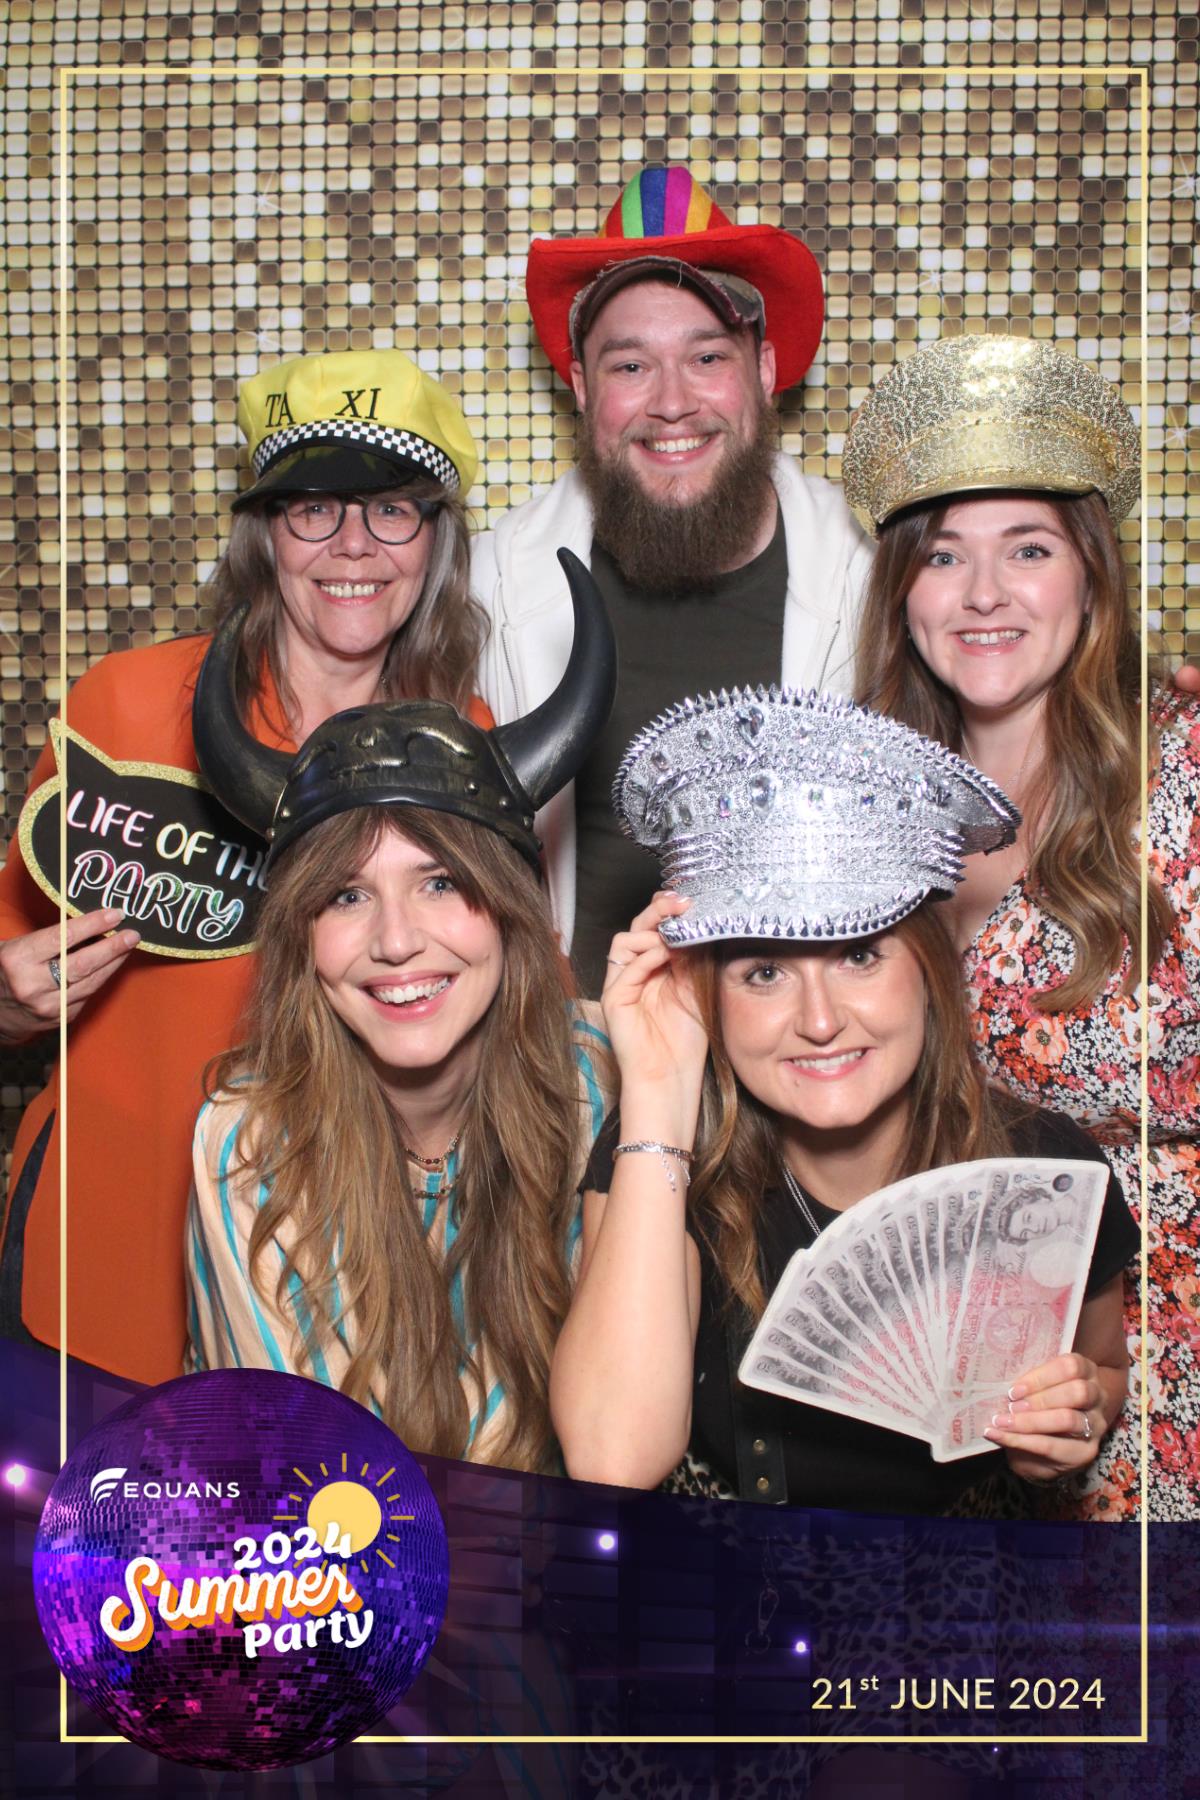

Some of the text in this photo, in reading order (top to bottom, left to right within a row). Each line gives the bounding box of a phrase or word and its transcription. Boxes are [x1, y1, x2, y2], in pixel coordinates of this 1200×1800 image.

[66, 790, 154, 847] LIFE
[156, 822, 215, 866] OF
[67, 849, 244, 942] PARTY
